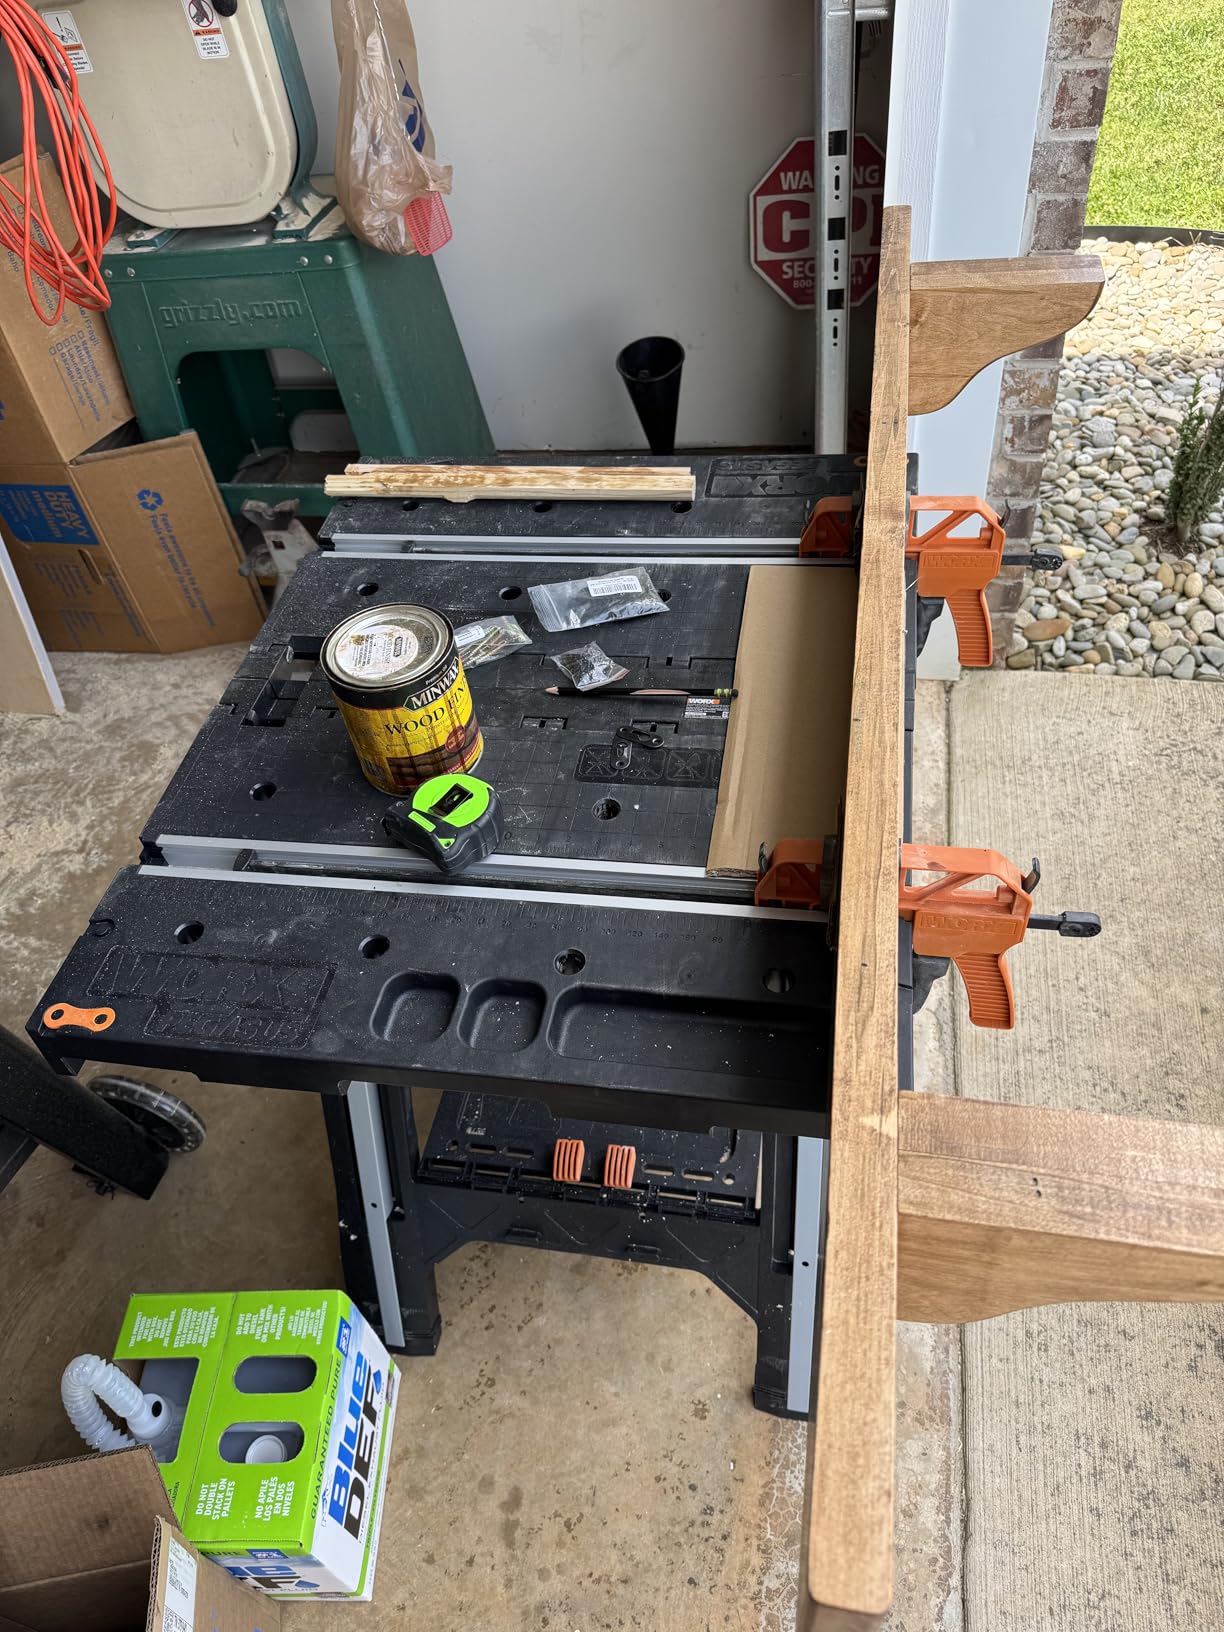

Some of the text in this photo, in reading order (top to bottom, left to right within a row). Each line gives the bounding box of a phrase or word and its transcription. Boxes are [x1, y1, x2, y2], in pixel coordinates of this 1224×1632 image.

[780, 165, 880, 191] WANG
[782, 256, 873, 279] SECTY
[158, 298, 303, 328] grizzly.com
[44, 491, 74, 529] DUTY
[56, 491, 91, 538] HEAVY
[410, 661, 459, 709] MINWAX
[385, 706, 445, 735] WOOD
[311, 1405, 333, 1520] GUARANTEED
[330, 1360, 343, 1402] PURE
[328, 1350, 368, 1526] Blue
[344, 1364, 378, 1541] DEF
[195, 1483, 209, 1515] DO NOT
[204, 1483, 218, 1516] DOUBLE
[211, 1478, 228, 1520] STACK ON
[221, 1481, 235, 1517] PALLETS
[254, 1479, 269, 1518] NO APILE
[263, 1504, 274, 1521] LOS
[273, 1483, 286, 1515] EN DOS
[282, 1481, 295, 1517] NIVELES
